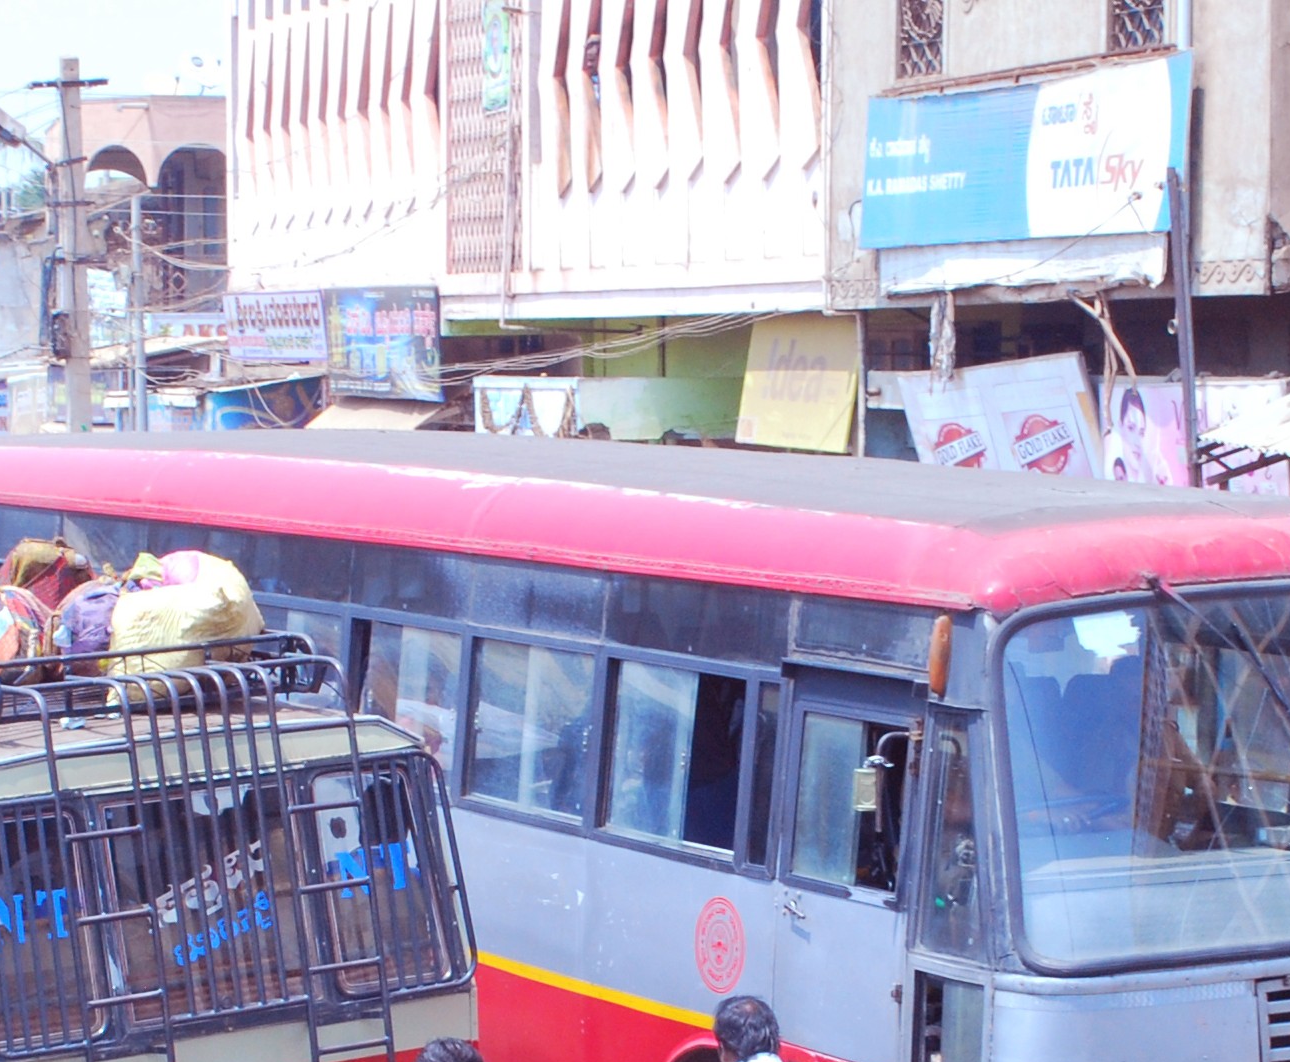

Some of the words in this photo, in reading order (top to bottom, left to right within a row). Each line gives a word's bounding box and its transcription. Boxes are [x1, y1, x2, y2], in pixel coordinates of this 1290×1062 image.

[1051, 157, 1095, 189] TATA
[1100, 153, 1144, 192] Sky
[1017, 438, 1043, 460] GOLD
[1043, 425, 1070, 449] FLAKE
